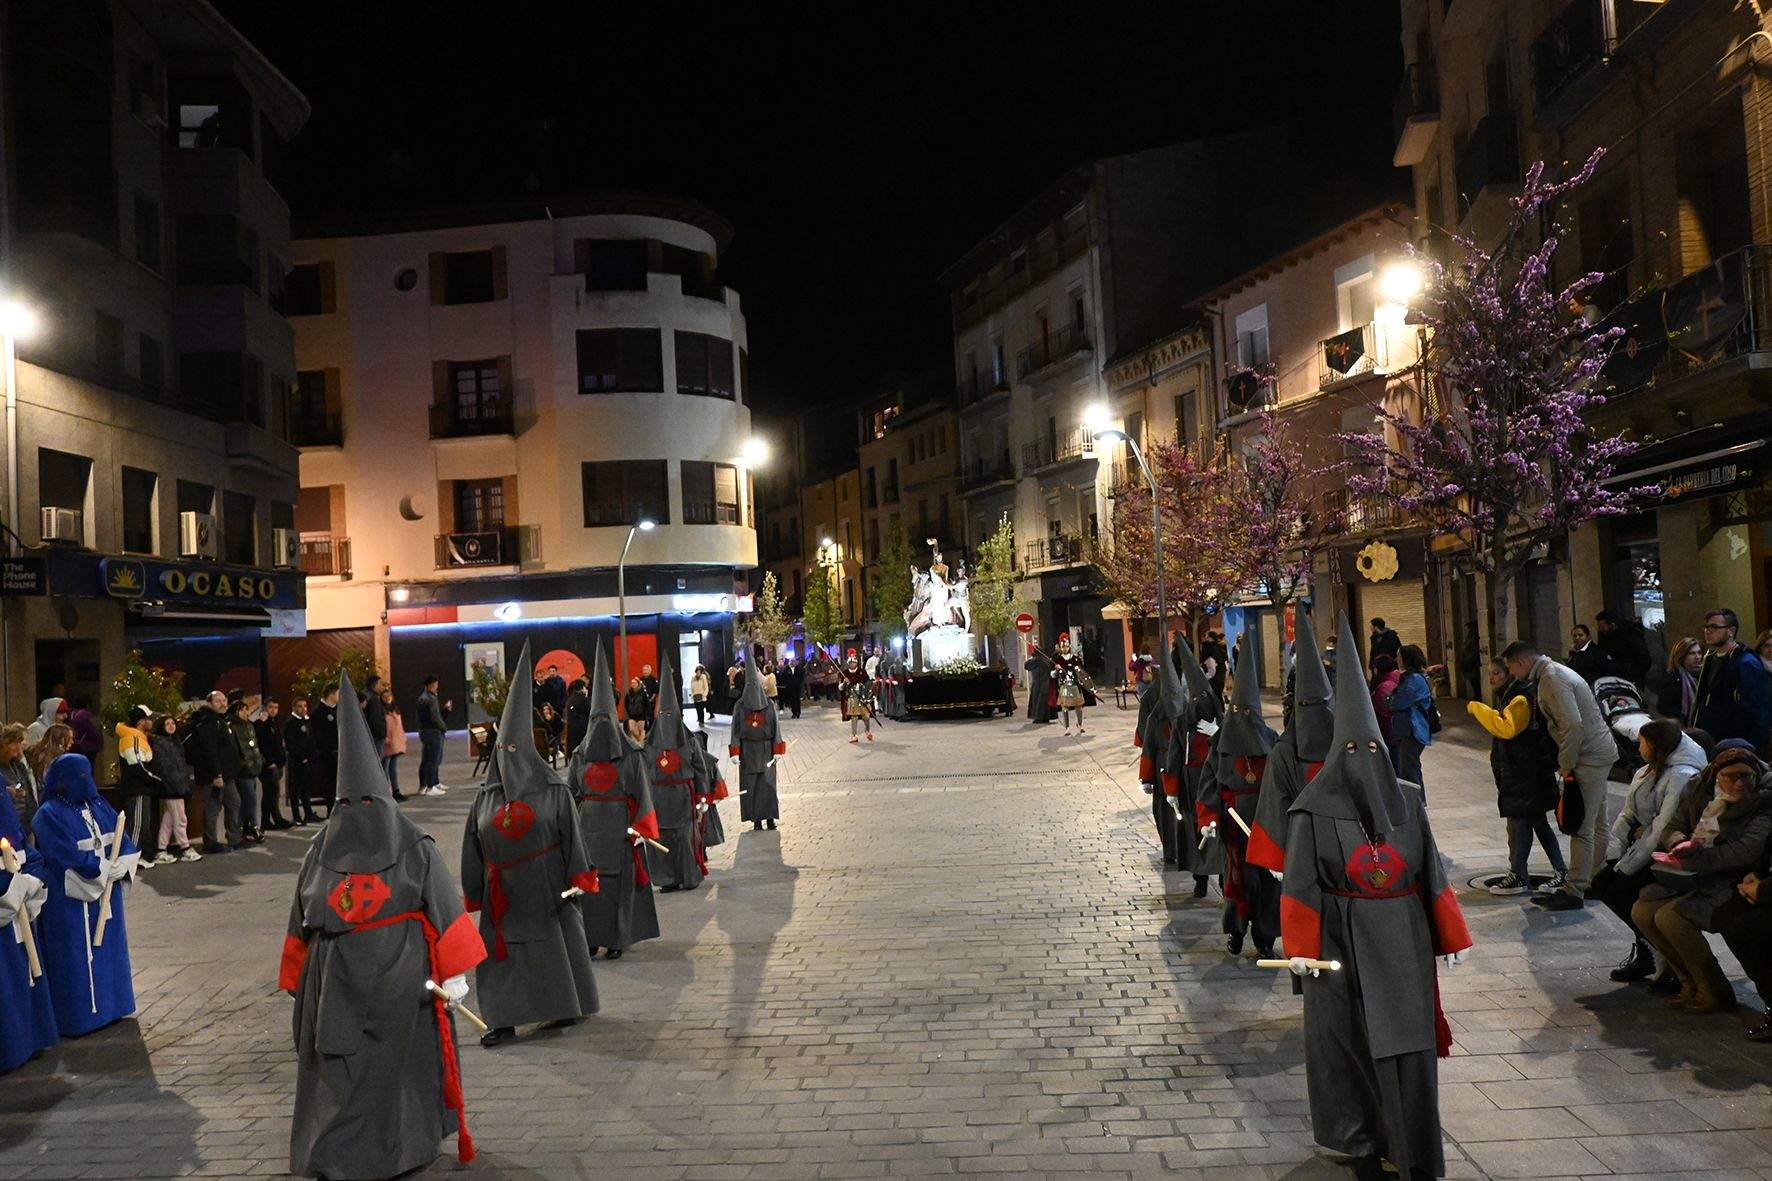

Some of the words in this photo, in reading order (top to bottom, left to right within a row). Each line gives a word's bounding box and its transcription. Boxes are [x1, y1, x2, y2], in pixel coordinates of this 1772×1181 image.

[3, 563, 24, 571] The
[3, 572, 37, 580] Phone
[3, 581, 37, 589] House
[164, 569, 276, 598] OCASO
